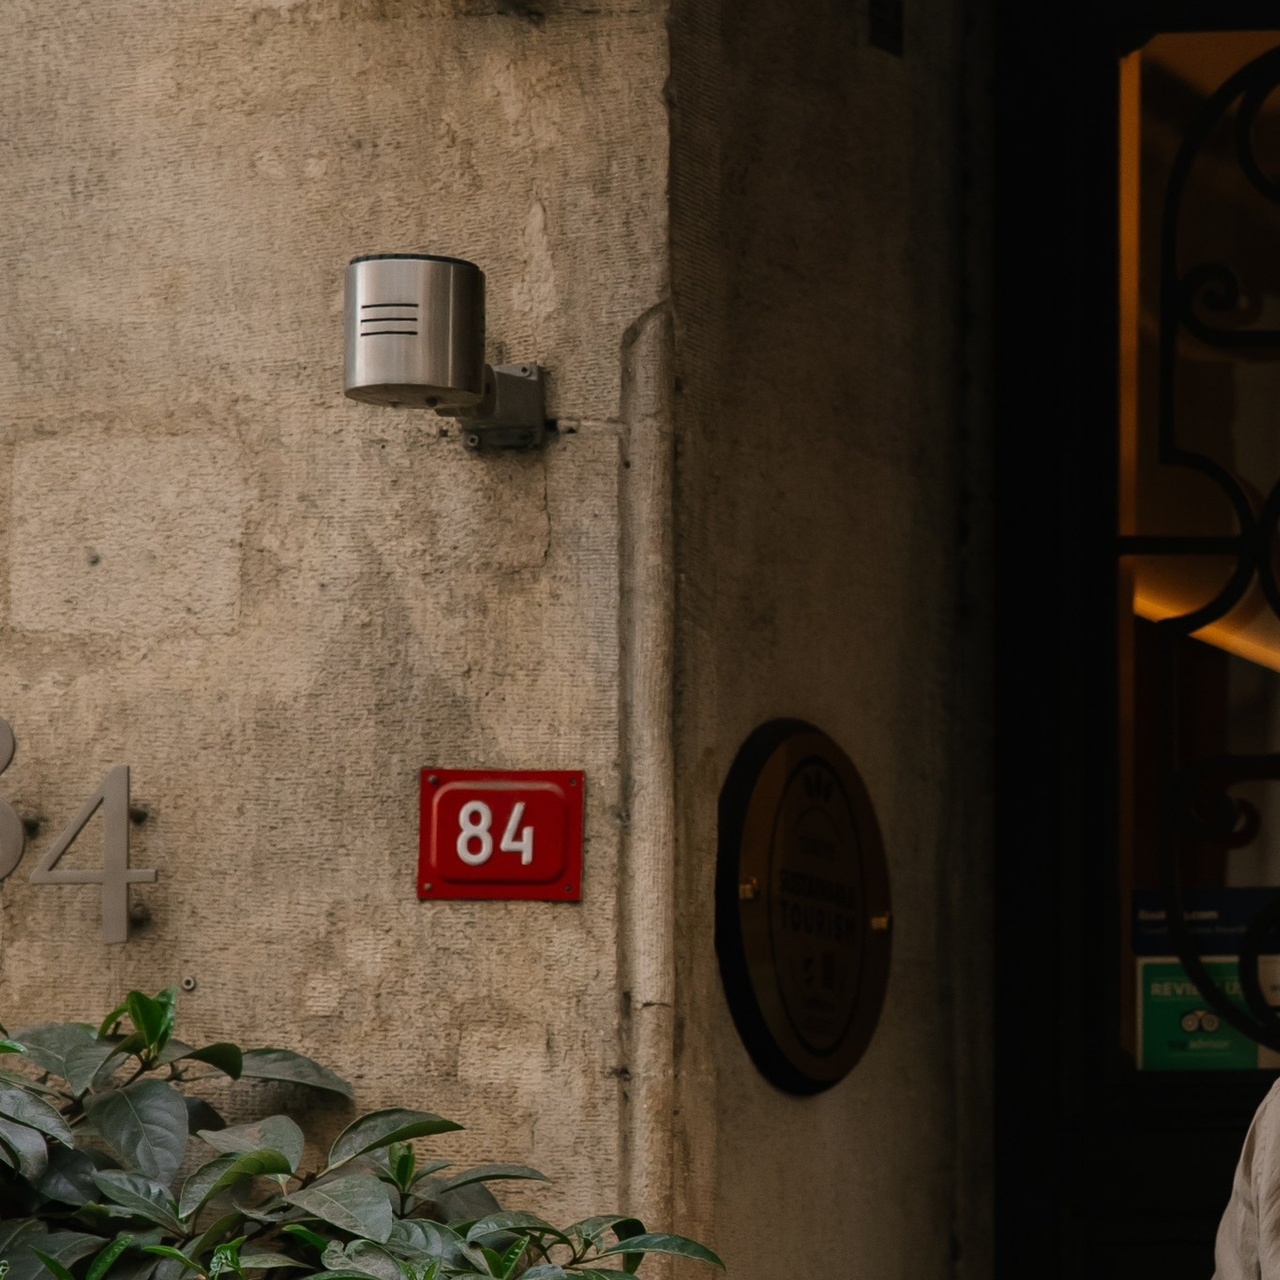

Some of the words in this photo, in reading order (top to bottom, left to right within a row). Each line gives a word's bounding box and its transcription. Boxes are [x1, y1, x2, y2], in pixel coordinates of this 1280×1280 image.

[0, 716, 157, 945] 4
[456, 800, 534, 866] 84
[779, 899, 857, 944] TOURISM
